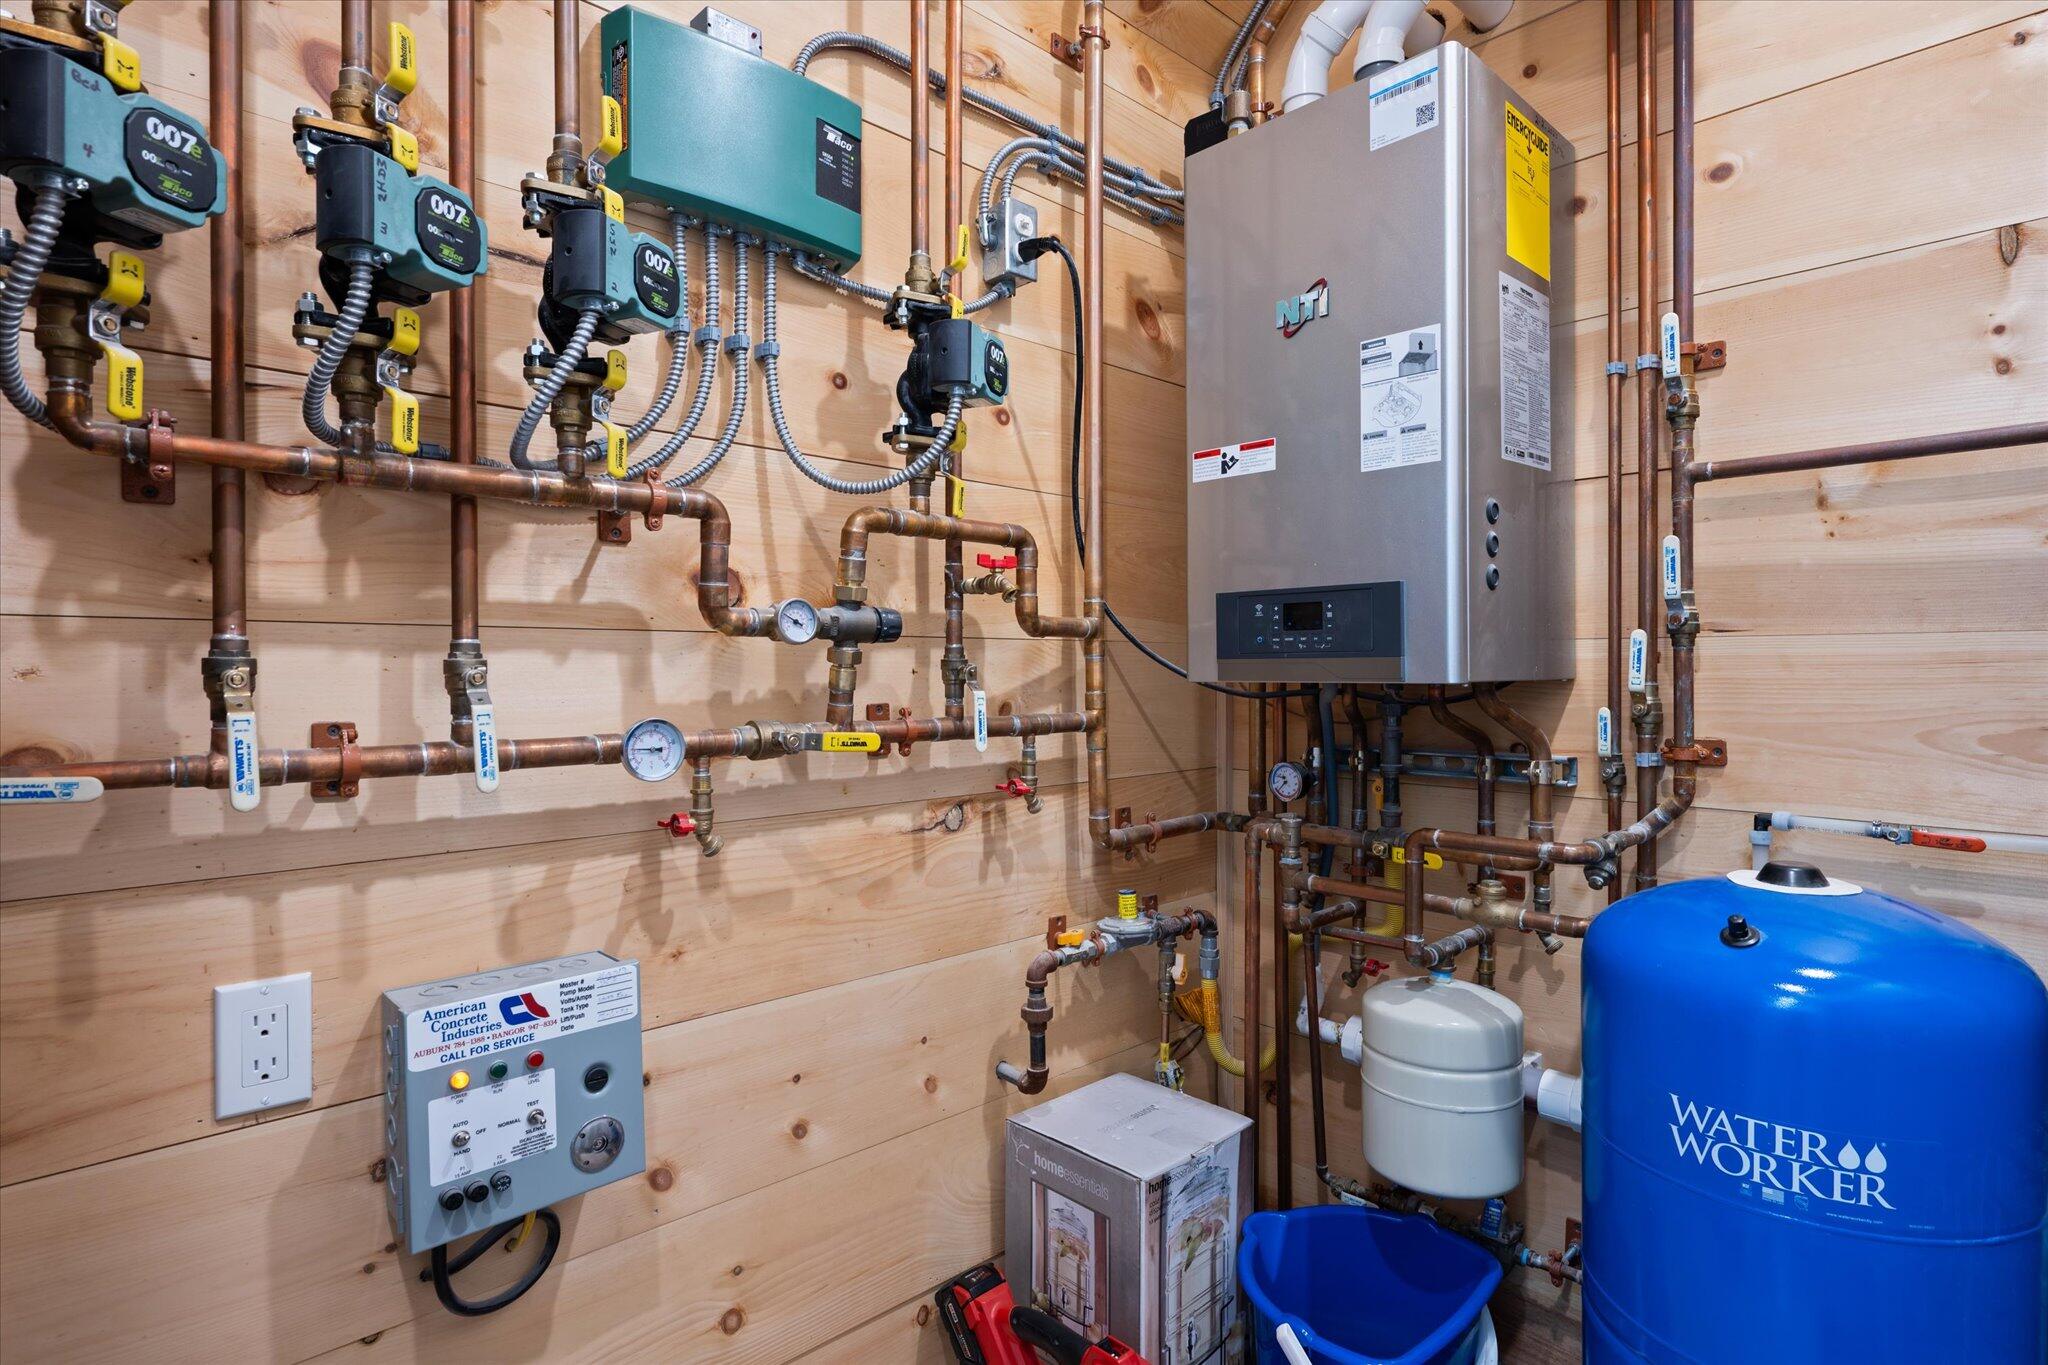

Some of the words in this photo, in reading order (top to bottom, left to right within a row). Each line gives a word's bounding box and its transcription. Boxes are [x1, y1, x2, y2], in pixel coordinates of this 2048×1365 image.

[146, 117, 203, 159] 007e
[823, 124, 852, 151] Taco
[430, 194, 471, 228] 007e
[645, 249, 674, 277] 007e
[1275, 287, 1329, 330] NTI
[125, 366, 136, 409] Webstone
[406, 407, 415, 445] Webstone
[235, 737, 245, 782] WATTS
[0, 790, 56, 799] WATT
[560, 989, 576, 997] Pump
[578, 984, 595, 993] Model
[422, 1001, 486, 1022] American
[431, 1013, 488, 1033] Concrete
[561, 1006, 574, 1014] Tank
[441, 1021, 502, 1042] Industries
[561, 1024, 574, 1032] Date
[413, 1044, 451, 1059] AUBURN
[492, 1026, 525, 1040] BANGOR
[440, 1050, 467, 1063] CALL
[470, 1044, 490, 1056] FOR
[493, 1033, 536, 1050] SERVICE
[452, 1120, 469, 1129] AUTO
[497, 1118, 521, 1128] NORMAL
[525, 1125, 546, 1135] SILENCE
[1669, 1092, 1839, 1168] WATER
[453, 1148, 471, 1156] HAND
[1034, 1150, 1109, 1200] homeessentials
[1669, 1122, 1896, 1210] WORKER
